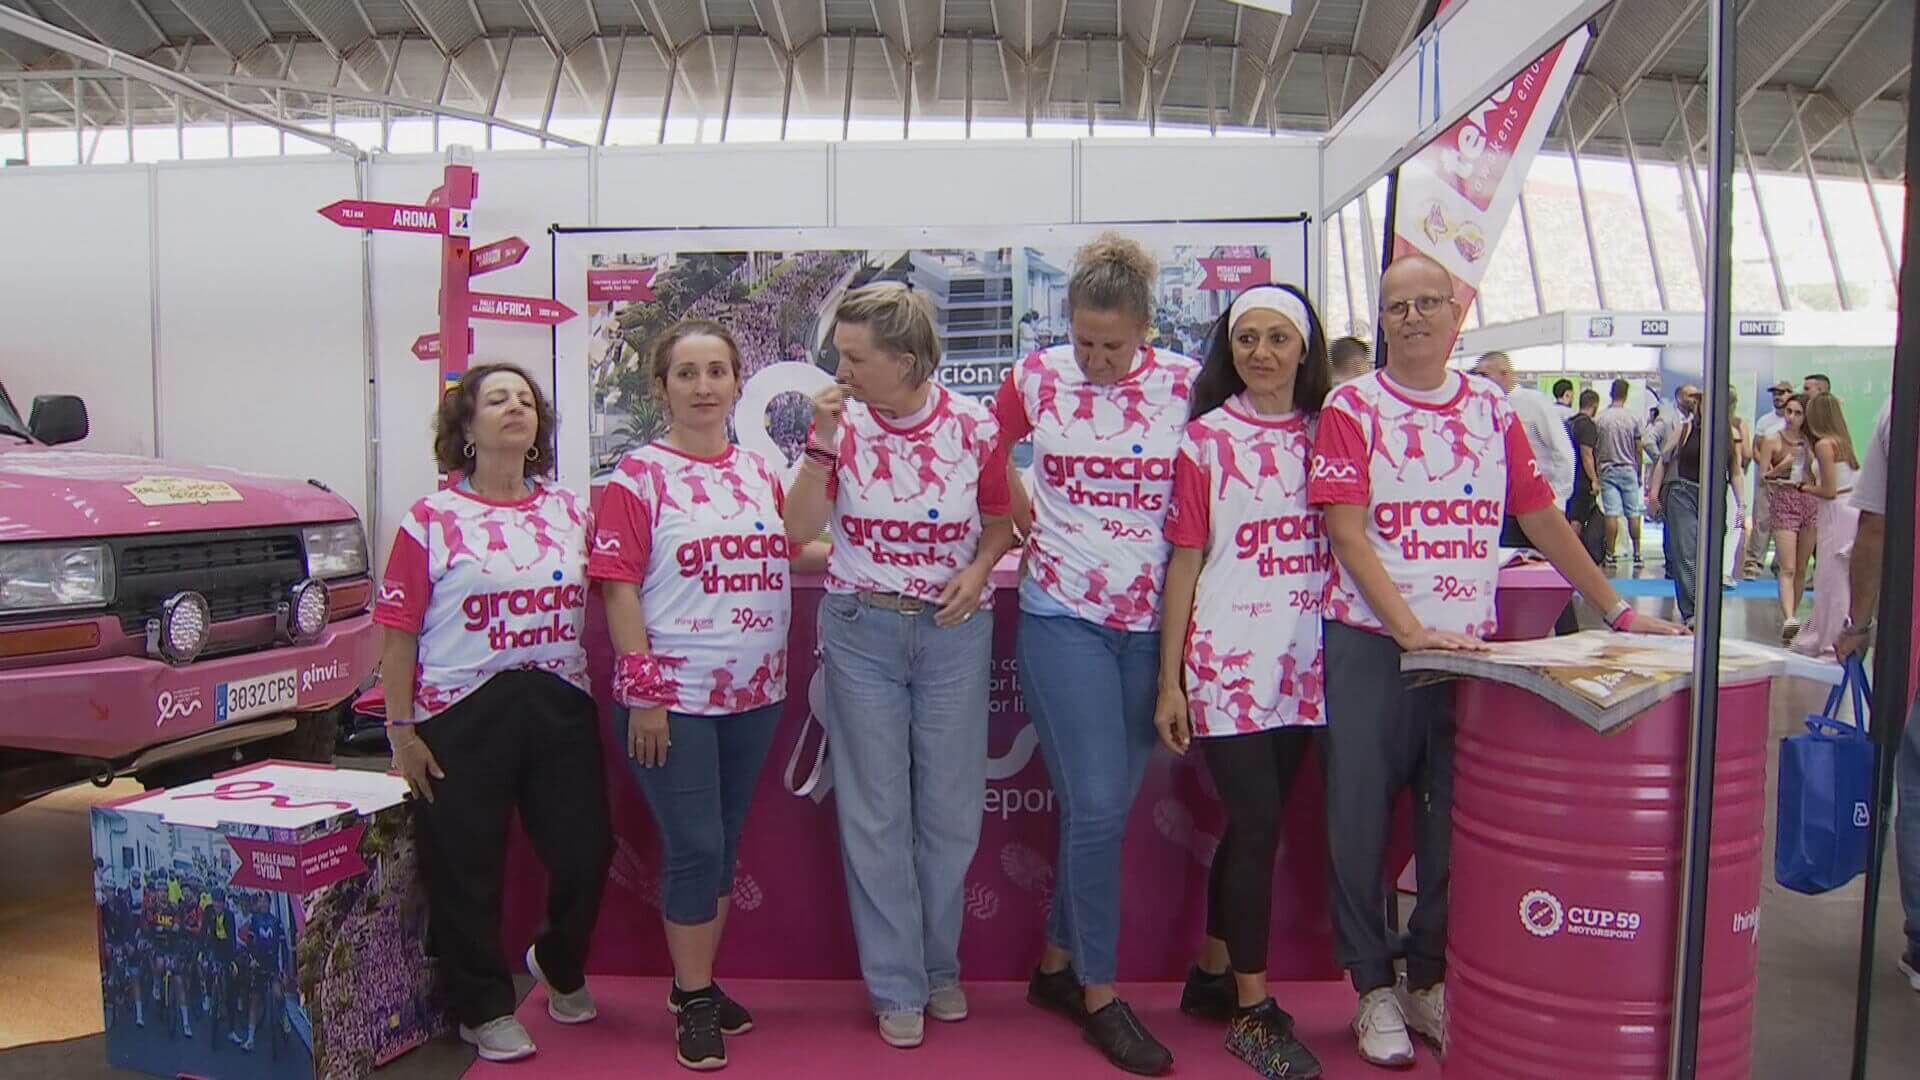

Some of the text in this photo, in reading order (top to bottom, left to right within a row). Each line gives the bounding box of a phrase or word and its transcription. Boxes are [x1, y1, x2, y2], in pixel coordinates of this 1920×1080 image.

[393, 209, 437, 229] ARONA
[496, 301, 532, 317] AFRICA
[1643, 320, 1667, 335] 208
[1067, 480, 1163, 511] thanks
[841, 509, 971, 546] gracias
[1235, 512, 1326, 560] graci
[676, 521, 790, 577] gracia
[869, 542, 958, 568] thanks
[1401, 528, 1488, 560] thanks
[1257, 541, 1331, 577] thank
[701, 562, 783, 594] thanks
[989, 678, 1007, 691] or
[989, 700, 1010, 713] or
[984, 787, 1055, 820] epor
[252, 850, 296, 868] PEDALEANDO
[261, 863, 283, 880] VIDA
[1567, 906, 1615, 926] CUP
[1616, 912, 1641, 929] 59
[1568, 925, 1637, 939] MOTORSPORT
